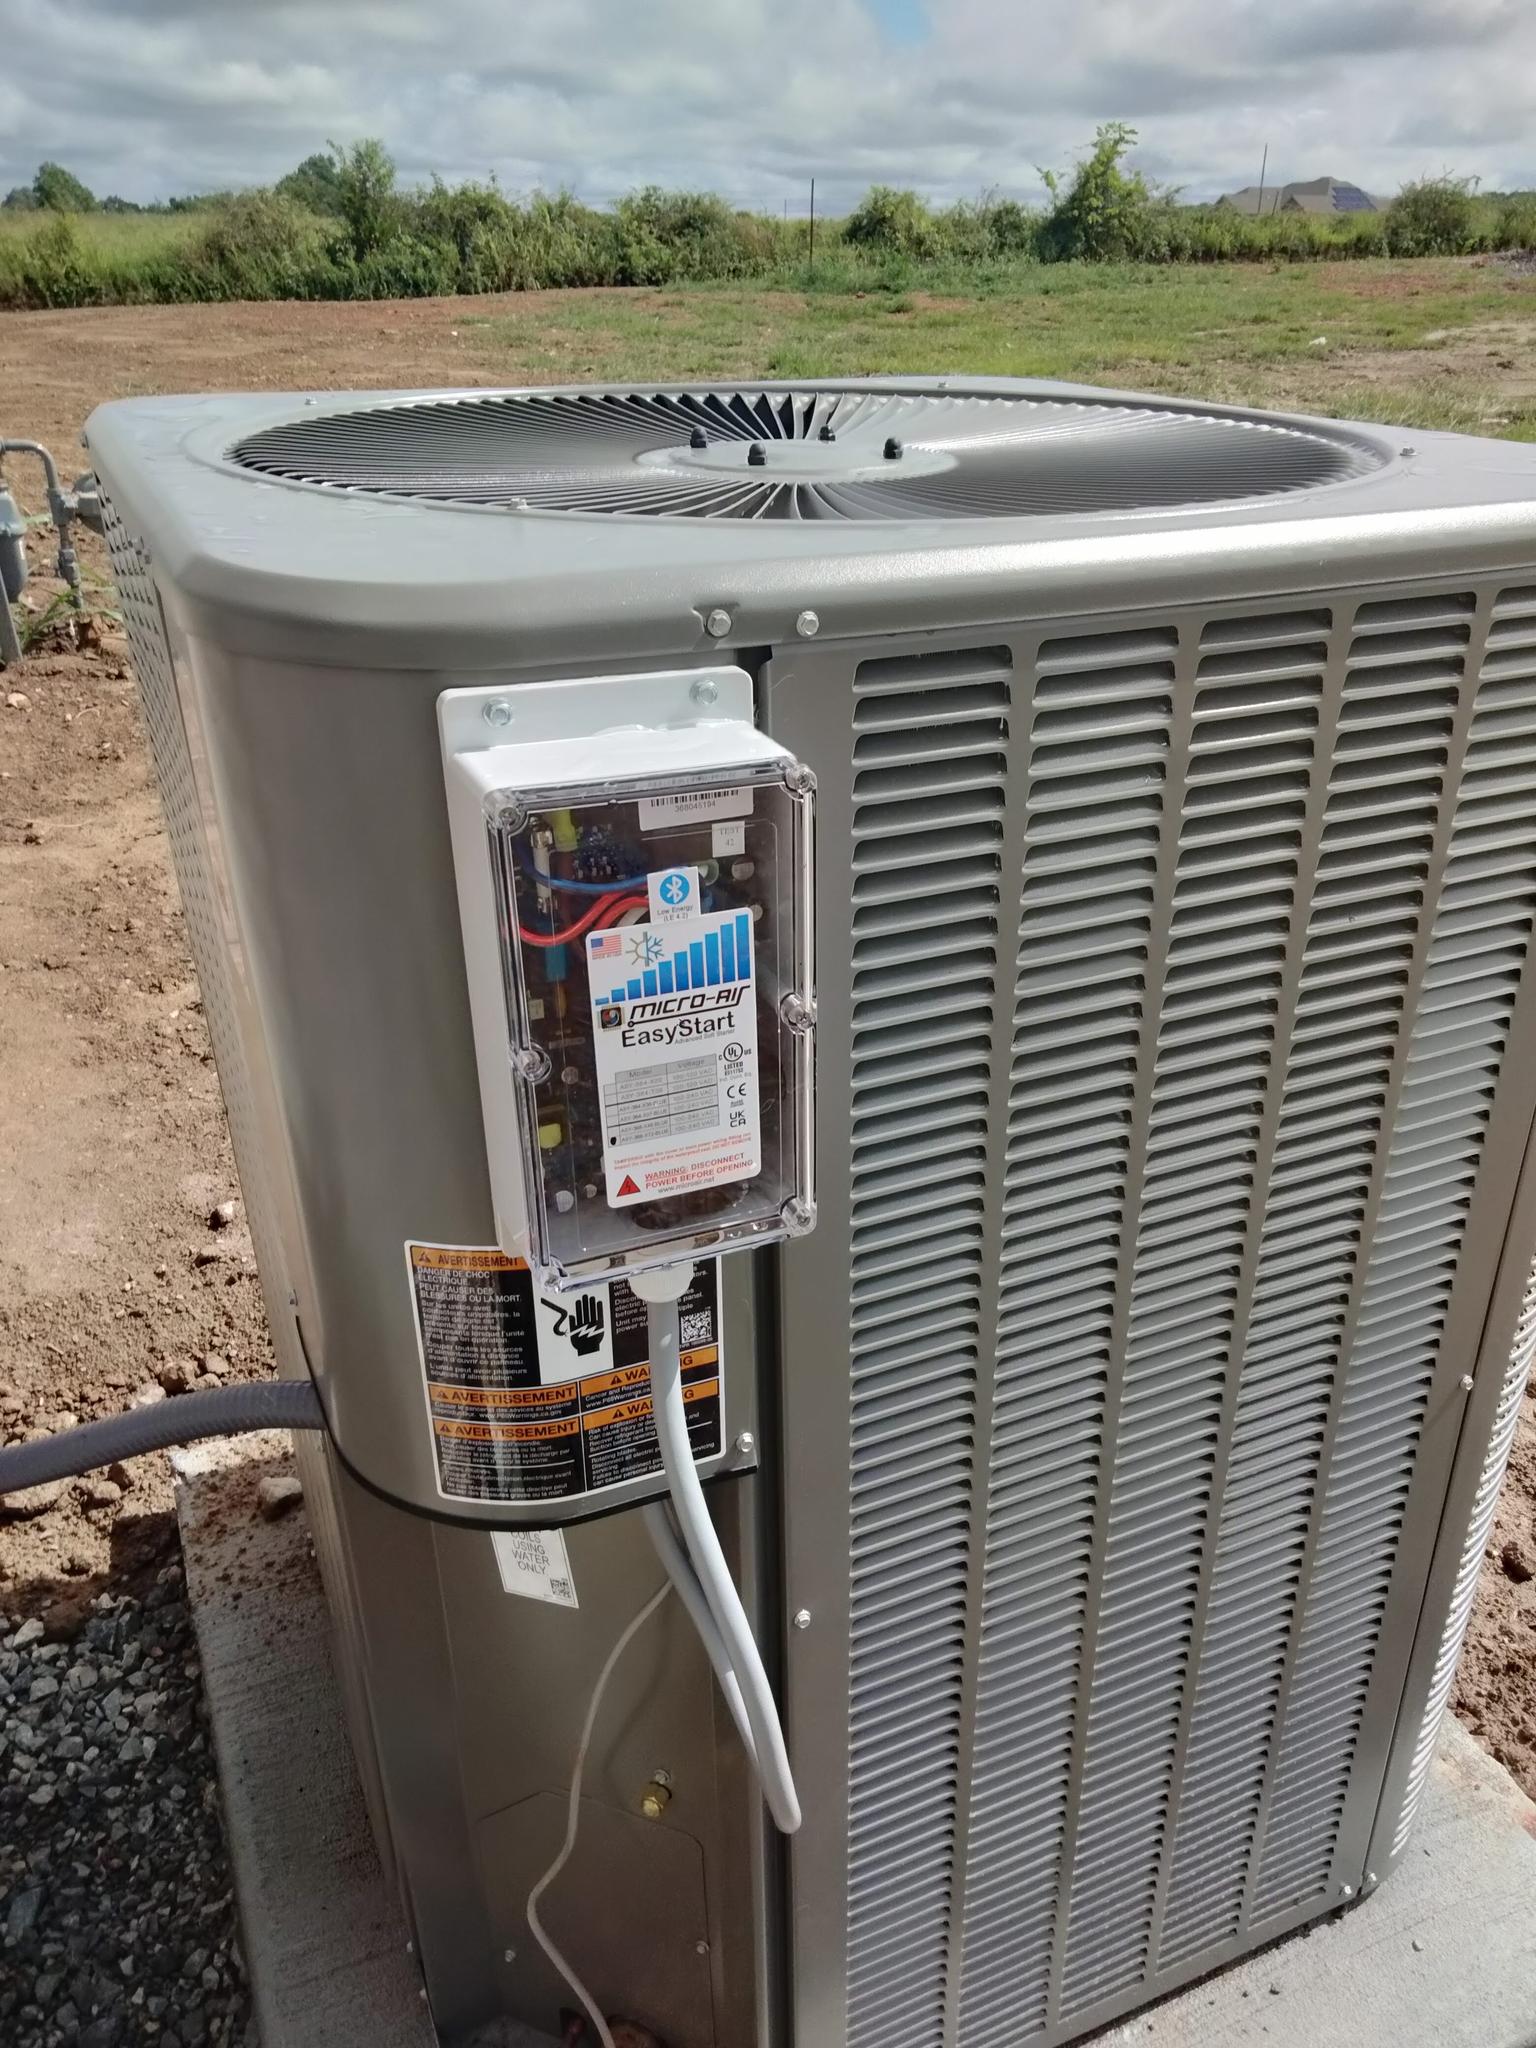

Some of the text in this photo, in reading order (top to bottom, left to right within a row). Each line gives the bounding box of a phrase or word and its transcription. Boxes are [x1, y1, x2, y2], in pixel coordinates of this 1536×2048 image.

[671, 904, 694, 913] Energy
[622, 1011, 736, 1048] EasyStart
[724, 1061, 744, 1071] LISTED
[729, 1110, 746, 1120] UK
[729, 1118, 746, 1128] CA
[691, 1152, 745, 1171] DISCONNECT
[645, 1159, 753, 1190] POWER BEFORE OPENING
[438, 1254, 519, 1268] AVERTISSEMENT
[417, 1267, 490, 1279] DANGER DE CHOC
[420, 1282, 440, 1292] PEUT
[441, 1285, 475, 1295] CAUSER
[421, 1290, 468, 1302] BLESSURES
[469, 1294, 482, 1302] OU
[483, 1295, 495, 1303] LA
[615, 1308, 638, 1318] before
[615, 1318, 631, 1327] Unit
[631, 1315, 647, 1325] may
[616, 1324, 638, 1335] power
[452, 1386, 575, 1405] AVERTISSEMENT
[585, 1391, 607, 1402] Cancer
[454, 1420, 577, 1438] AVERTISSEMENT
[609, 1416, 638, 1432] explosion
[589, 1435, 613, 1447] Recover
[614, 1427, 644, 1441] refrigerant
[591, 1454, 616, 1464] Rotating
[592, 1456, 624, 1470] Disconnect
[633, 1447, 654, 1459] electric
[620, 1460, 652, 1473] disconnect
[623, 1467, 648, 1479] personal
[512, 1539, 545, 1555] USING
[511, 1549, 549, 1567] WATER
[517, 1560, 546, 1575] ONLY
